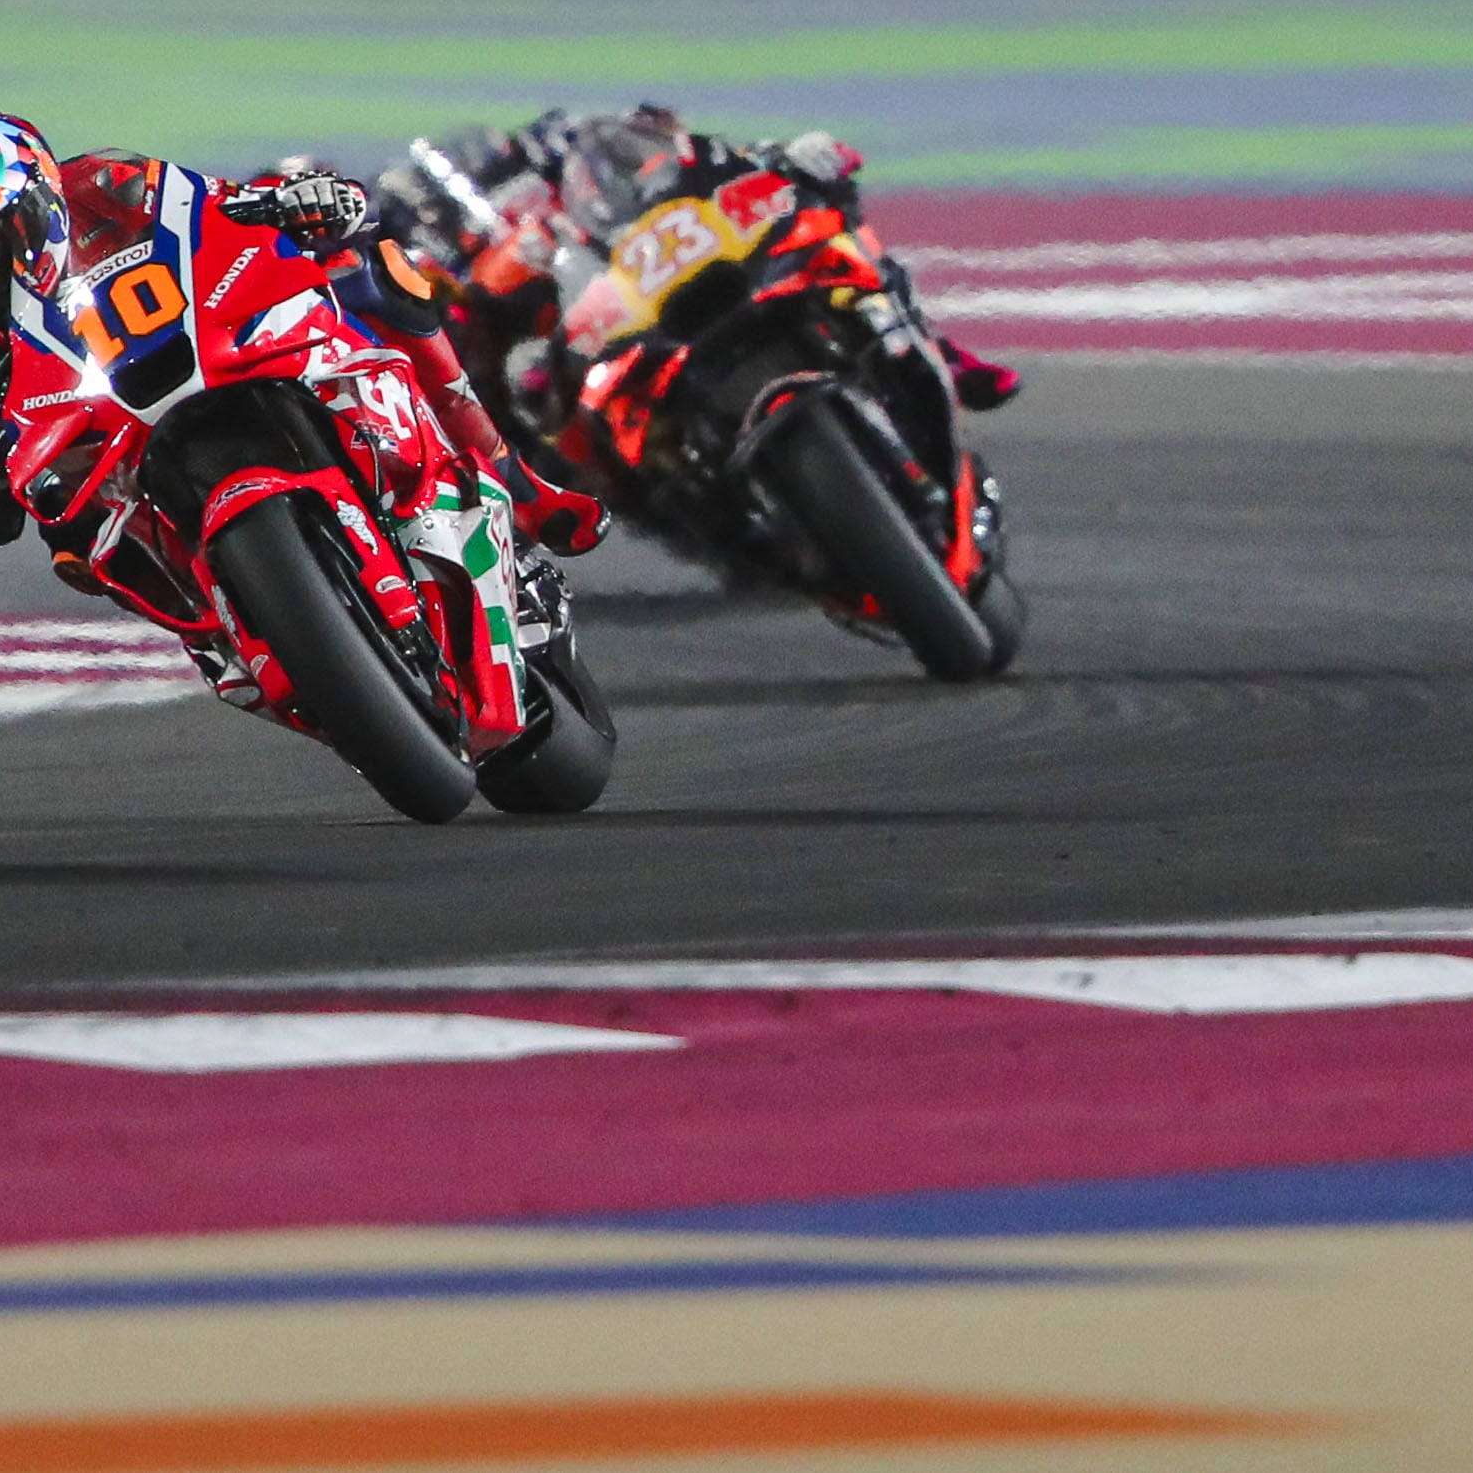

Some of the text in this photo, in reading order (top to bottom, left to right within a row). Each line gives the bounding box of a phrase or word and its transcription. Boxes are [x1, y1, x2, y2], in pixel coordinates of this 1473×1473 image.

[203, 246, 261, 310] HONDA
[622, 206, 720, 297] 23
[70, 263, 189, 368] 10
